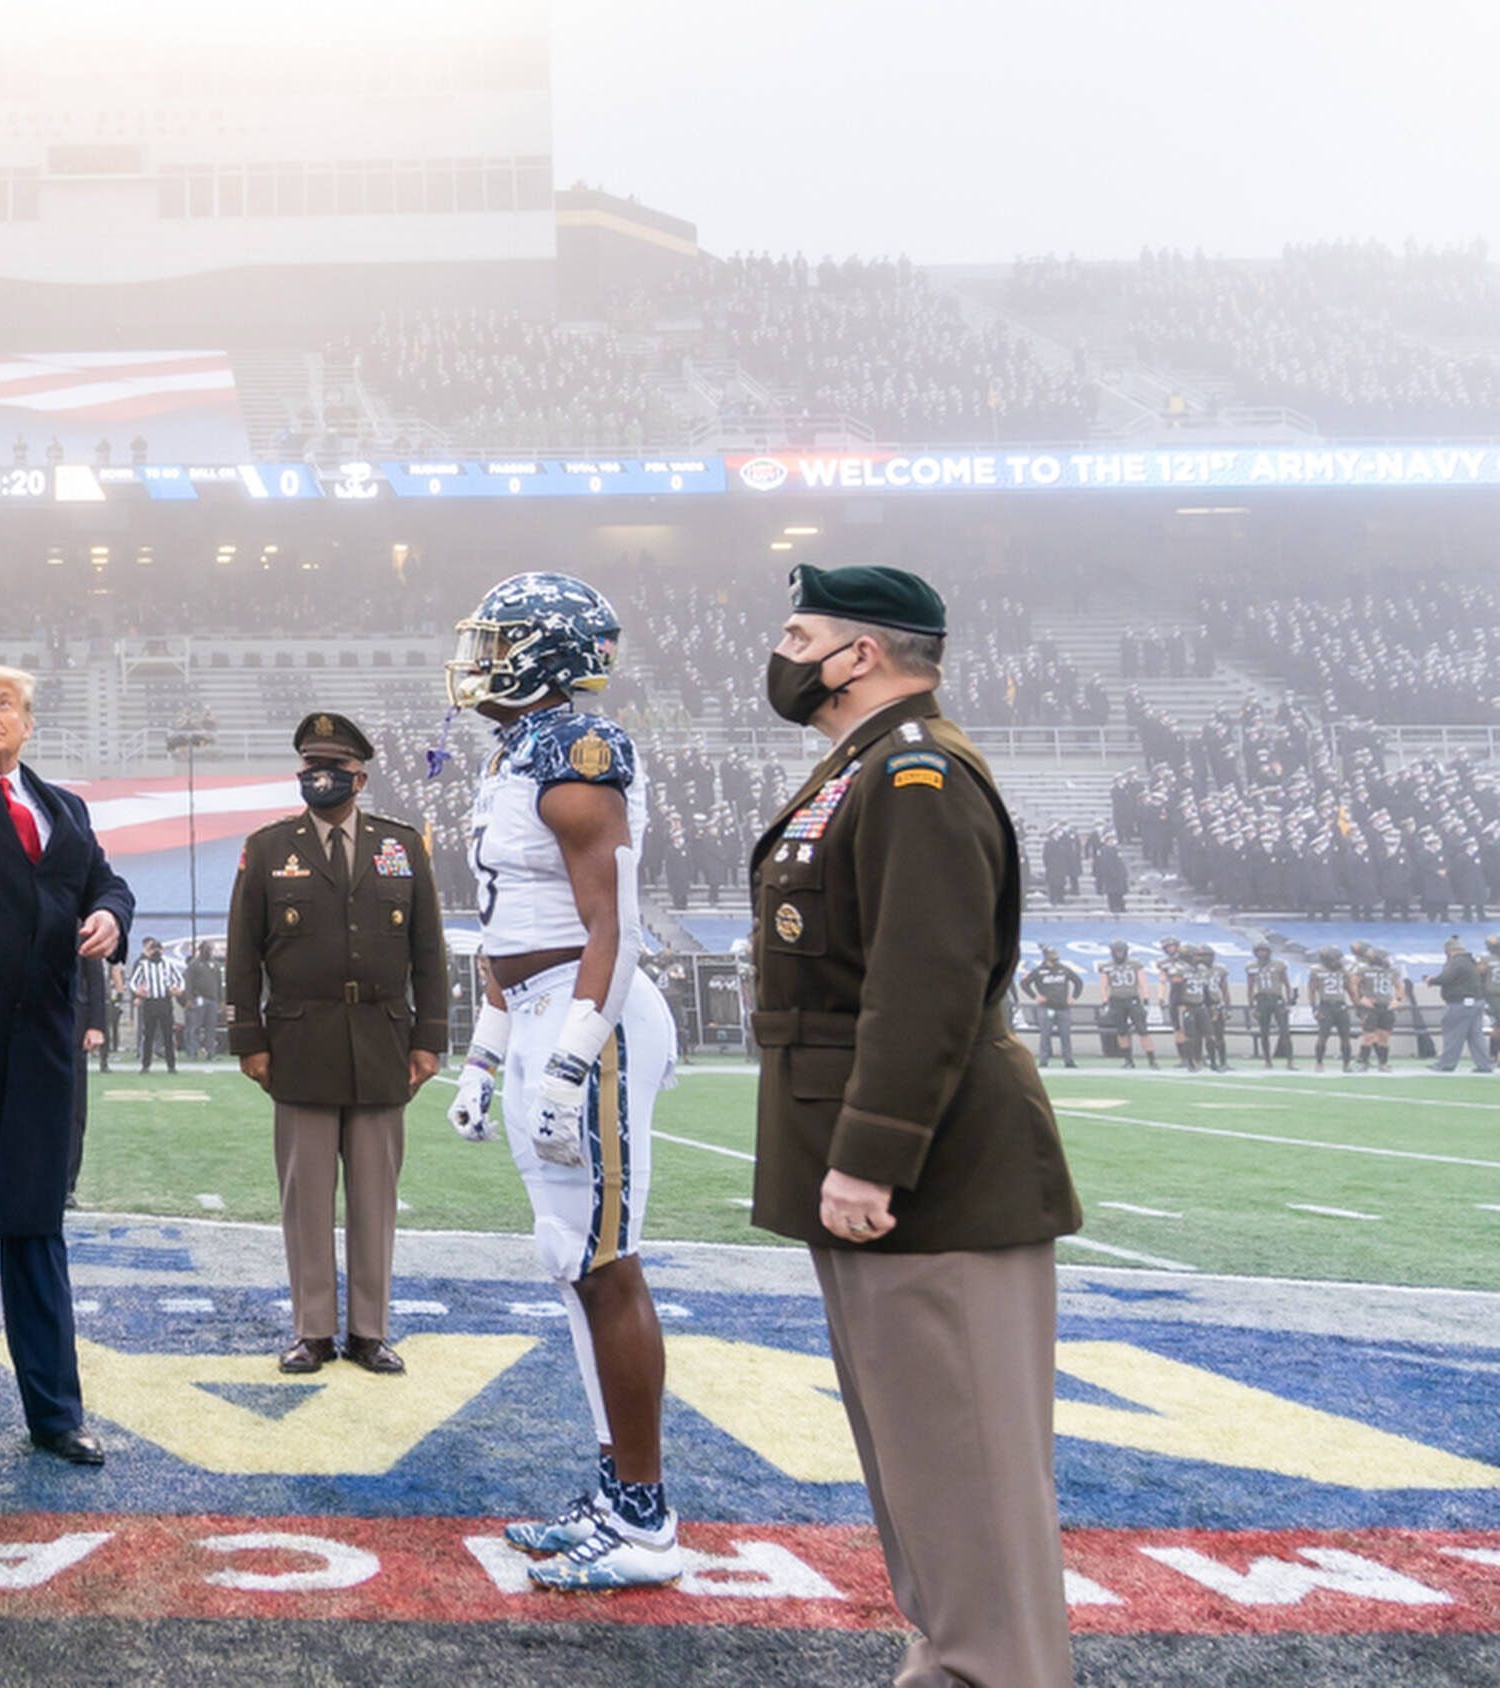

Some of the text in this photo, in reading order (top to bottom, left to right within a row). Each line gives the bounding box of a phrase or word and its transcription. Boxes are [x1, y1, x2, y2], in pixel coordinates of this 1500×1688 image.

[798, 457, 995, 487] WELCOME
[1006, 456, 1061, 485] TO
[1071, 454, 1146, 483] THE
[1250, 450, 1486, 482] ARMY-NAVY
[280, 469, 299, 496] 0
[1109, 969, 1135, 987] 30
